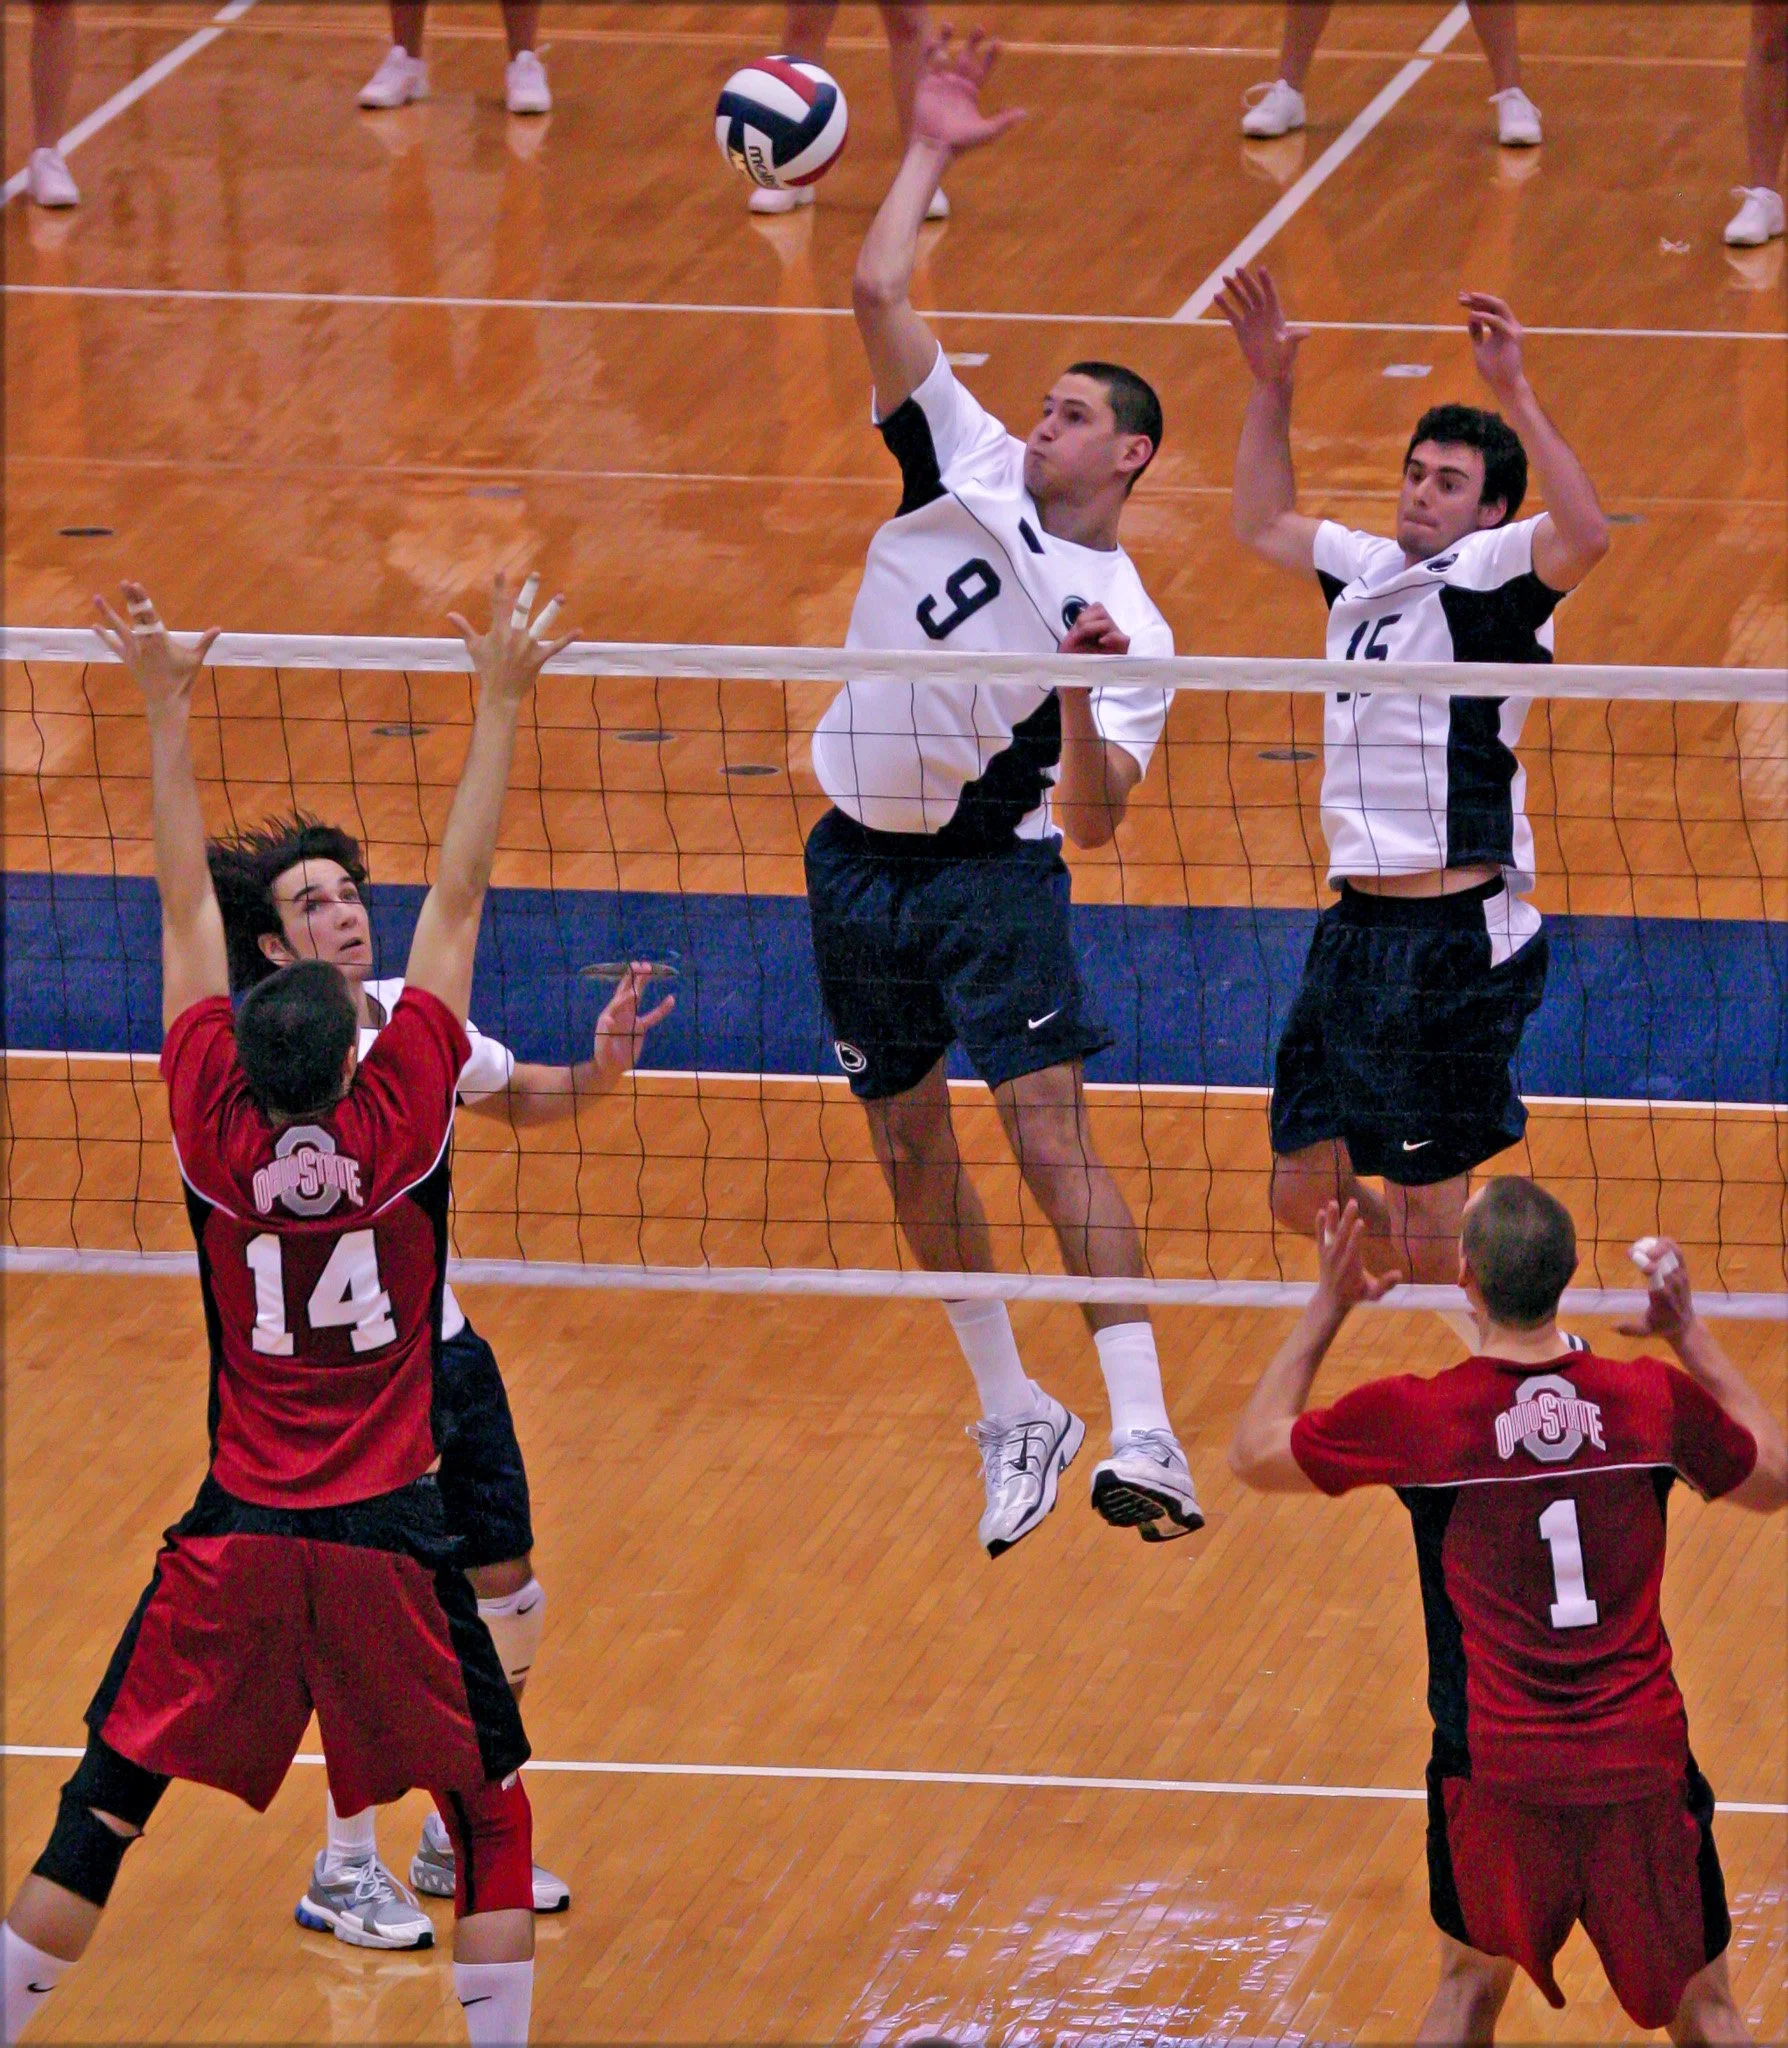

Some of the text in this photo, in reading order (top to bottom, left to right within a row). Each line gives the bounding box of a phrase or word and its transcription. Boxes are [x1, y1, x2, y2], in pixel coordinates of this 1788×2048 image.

[917, 558, 1001, 639] 9
[1337, 613, 1402, 702] 15
[252, 1147, 363, 1214] OHIO STATE
[246, 1229, 397, 1356] 14
[1495, 1393, 1606, 1460] OHIO STATE
[1538, 1499, 1598, 1628] 1
